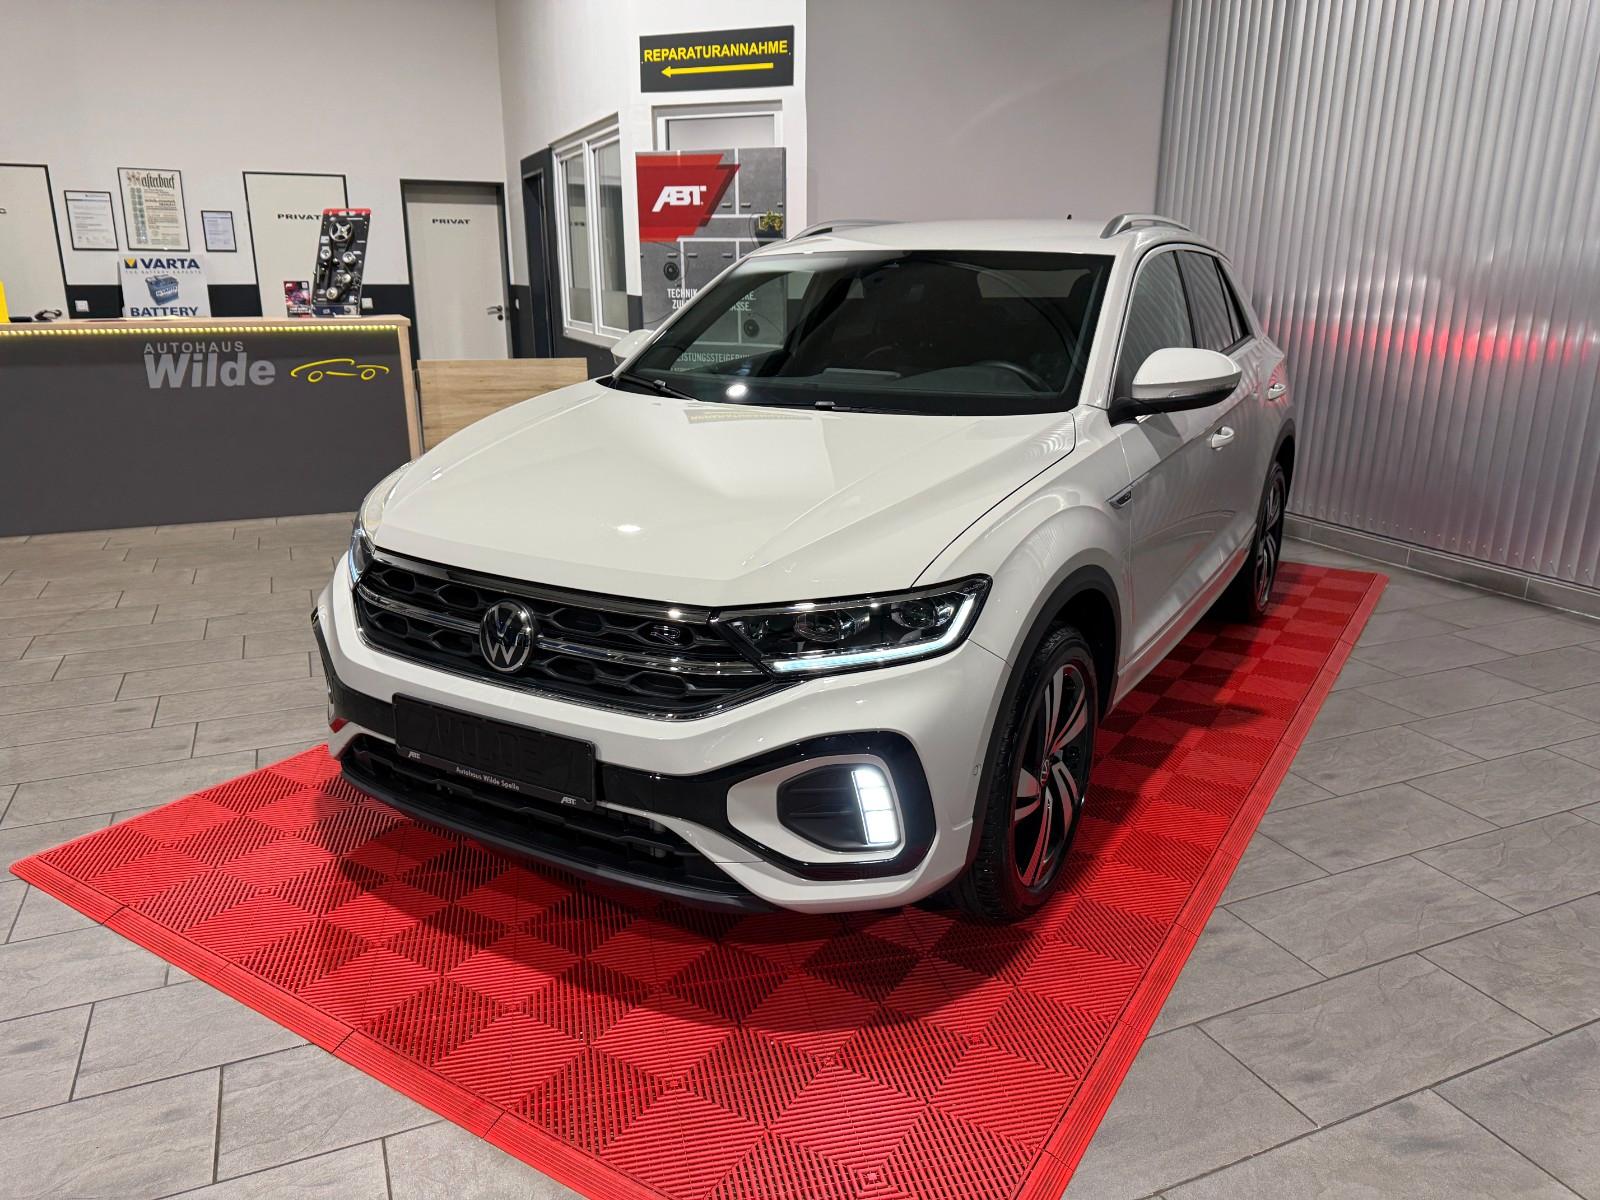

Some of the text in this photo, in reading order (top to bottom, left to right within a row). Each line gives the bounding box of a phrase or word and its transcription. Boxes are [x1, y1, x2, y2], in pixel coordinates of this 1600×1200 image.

[643, 40, 788, 62] REPARATURANNAHME
[652, 185, 707, 212] ABT
[140, 258, 200, 269] VARTA
[130, 306, 199, 317] BATTERY
[144, 341, 244, 354] AUTOHAUS
[143, 352, 276, 389] Wilde
